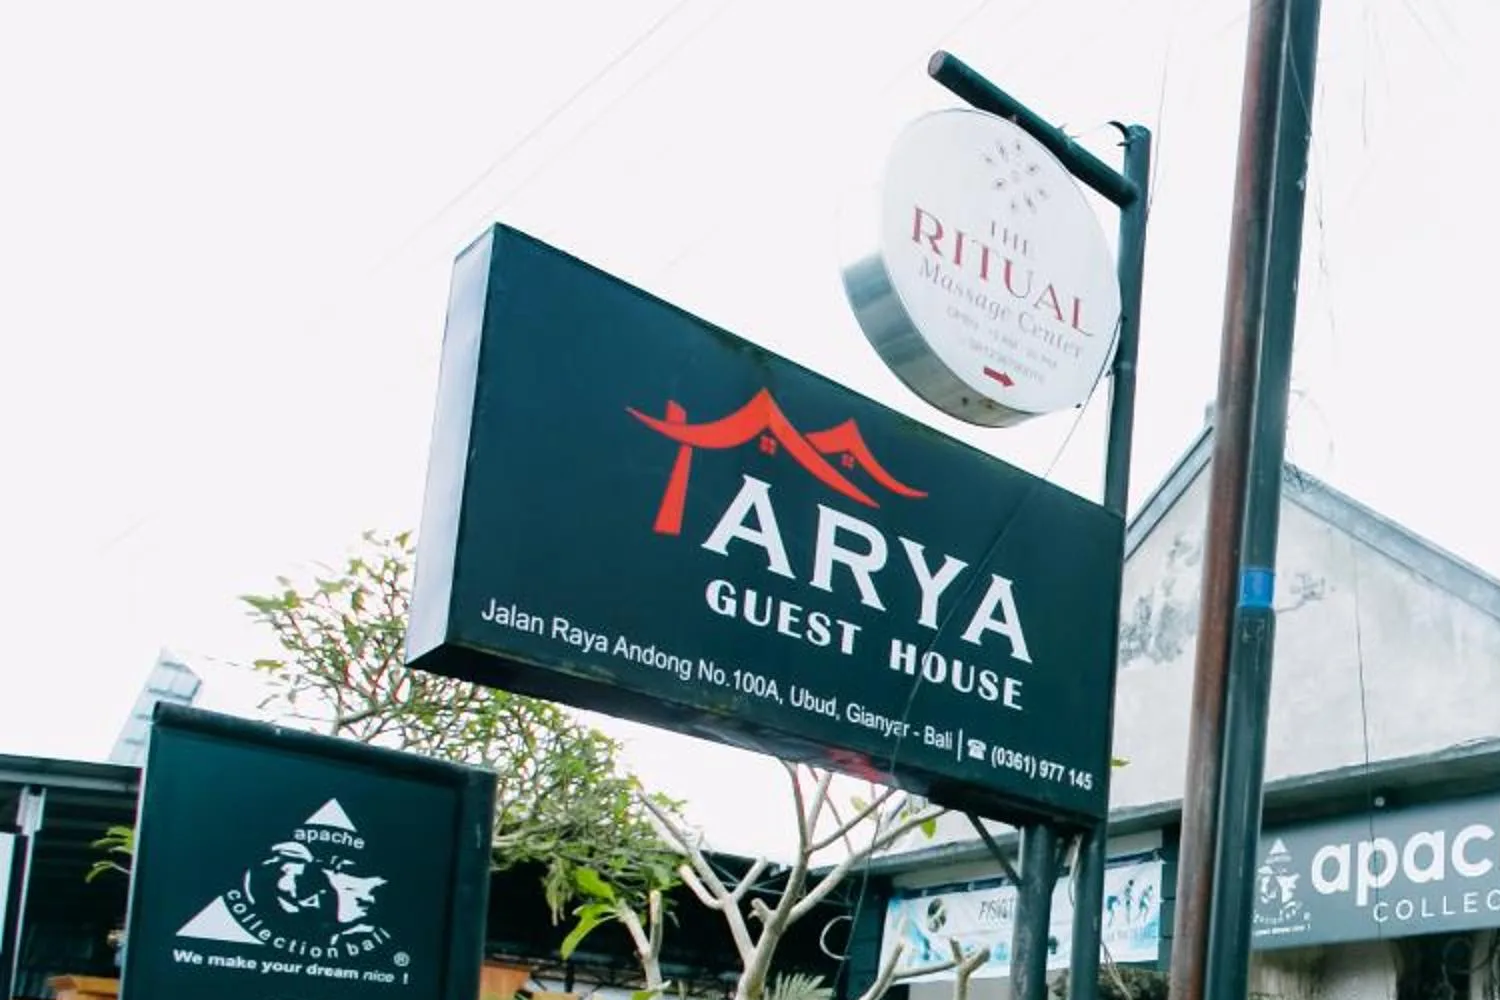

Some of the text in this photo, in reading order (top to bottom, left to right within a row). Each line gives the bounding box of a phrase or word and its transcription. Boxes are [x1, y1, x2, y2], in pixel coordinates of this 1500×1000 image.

[911, 204, 1094, 337] RITUAL
[919, 257, 1012, 319] Massage
[1018, 310, 1085, 358] Center
[482, 599, 544, 635] Jalan
[552, 617, 608, 652] Raya
[613, 636, 692, 680] Andong
[791, 686, 840, 720] Ubud,
[847, 703, 909, 736] Gianyar
[924, 726, 952, 749] Bali
[992, 746, 1036, 778] (0361)
[1040, 760, 1064, 781] 977
[1069, 769, 1092, 790] 145
[706, 580, 1022, 710] GUEST HOUSE
[294, 829, 364, 849] apache
[173, 949, 203, 964] We
[208, 956, 257, 969] make
[261, 961, 302, 973] your
[306, 964, 358, 979] dream
[363, 970, 395, 982] nice
[227, 890, 338, 958] collection
